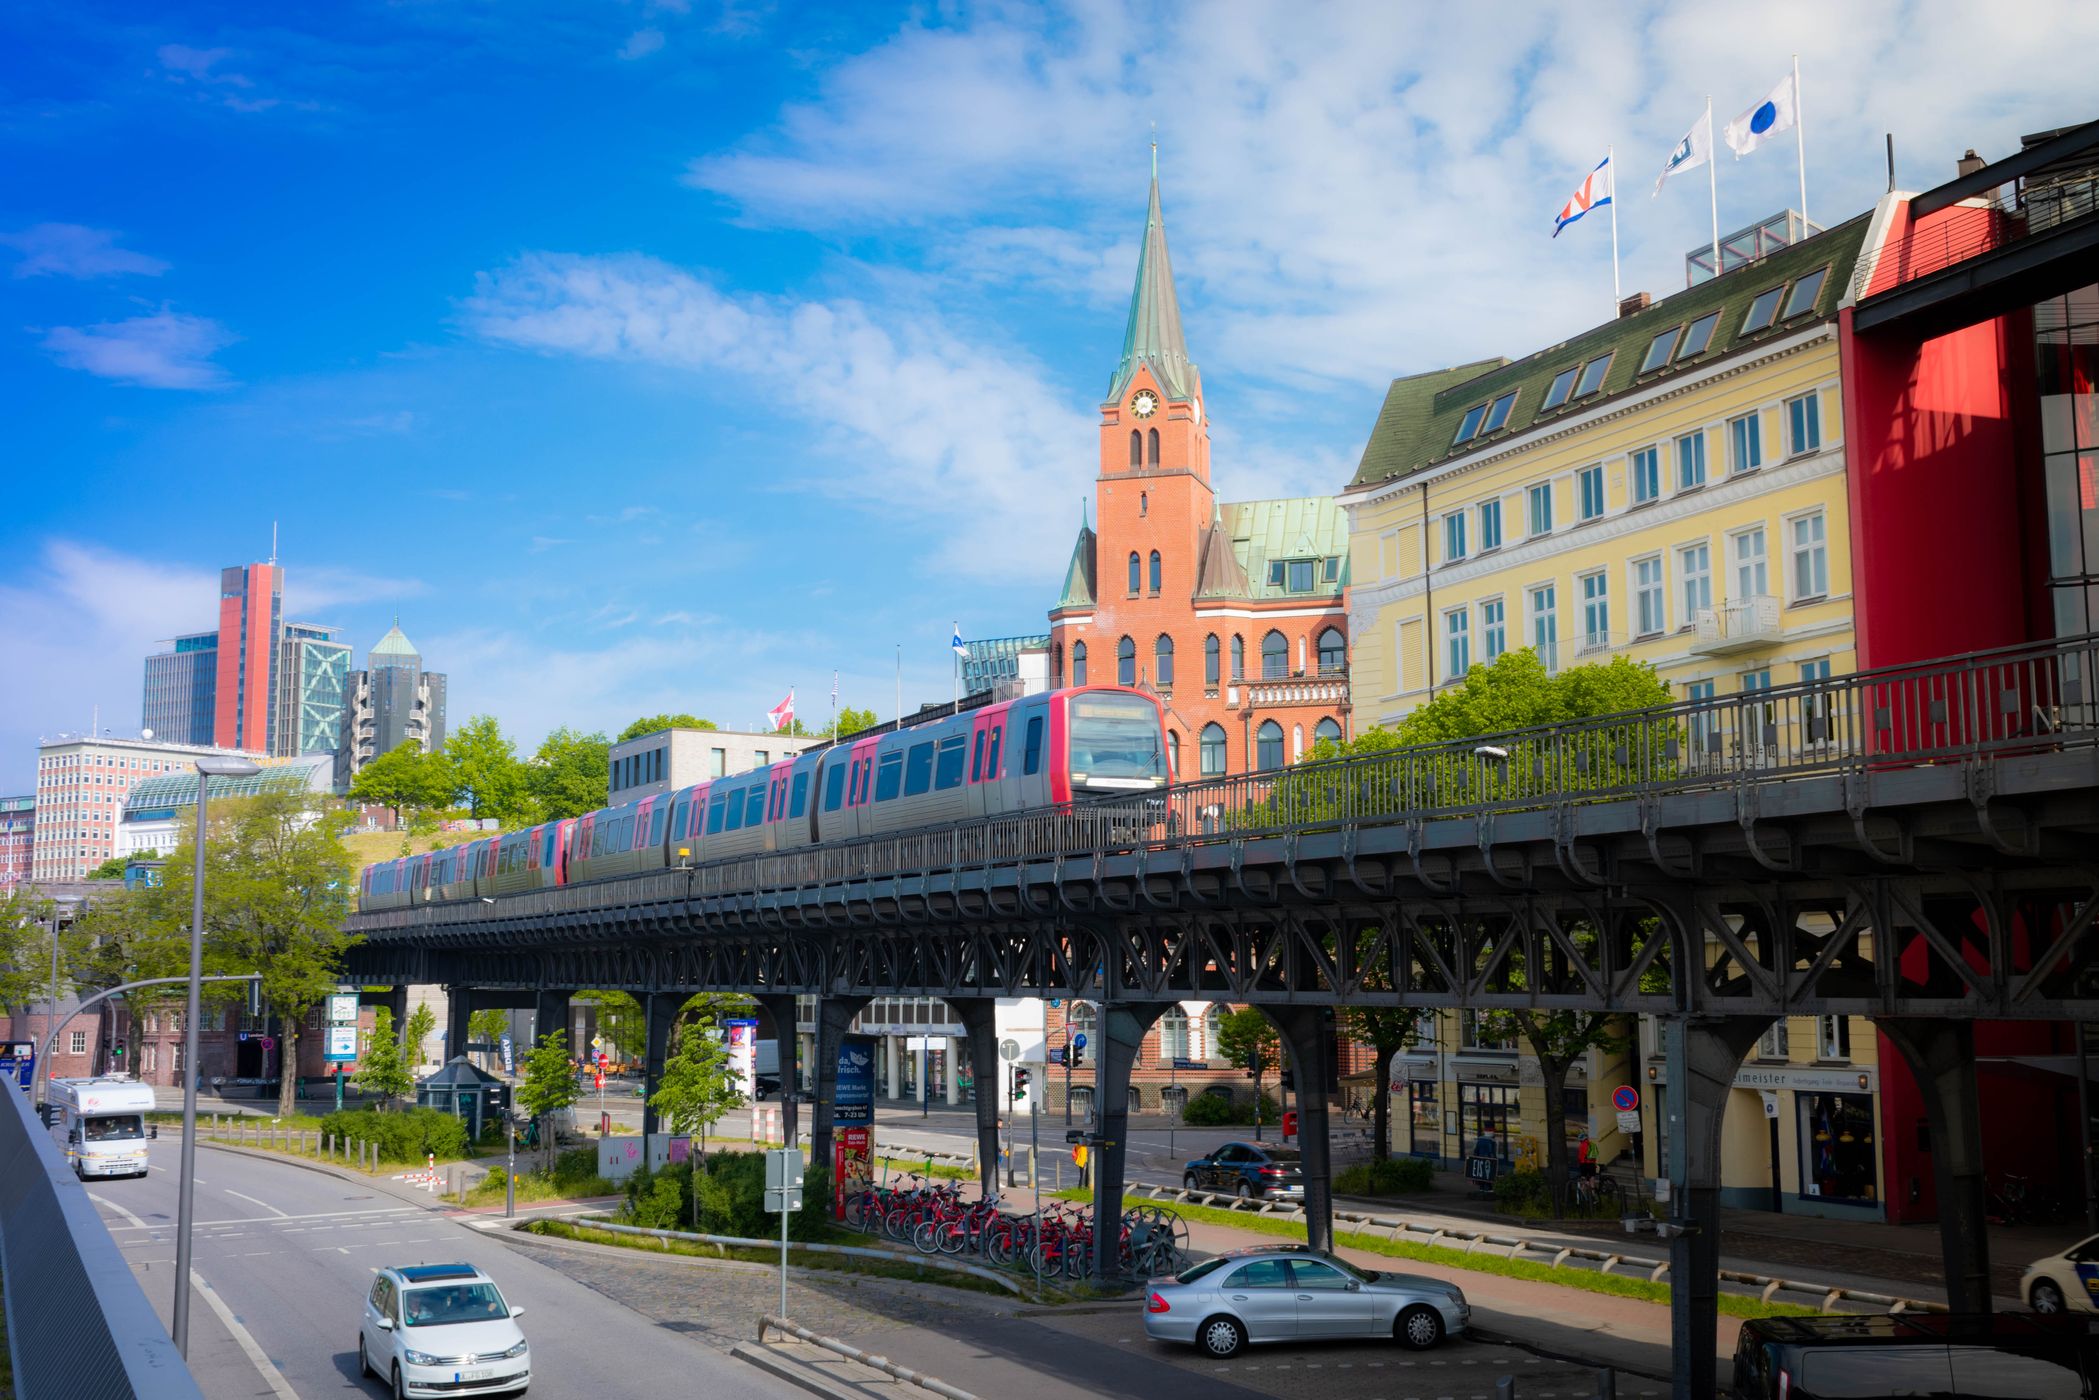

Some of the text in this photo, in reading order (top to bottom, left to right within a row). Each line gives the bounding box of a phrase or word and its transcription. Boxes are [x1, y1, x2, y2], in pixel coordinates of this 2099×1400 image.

[240, 1033, 247, 1041] U
[502, 1039, 513, 1071] EDEKA
[848, 1133, 866, 1141] REWE
[1472, 1159, 1484, 1178] EIS
